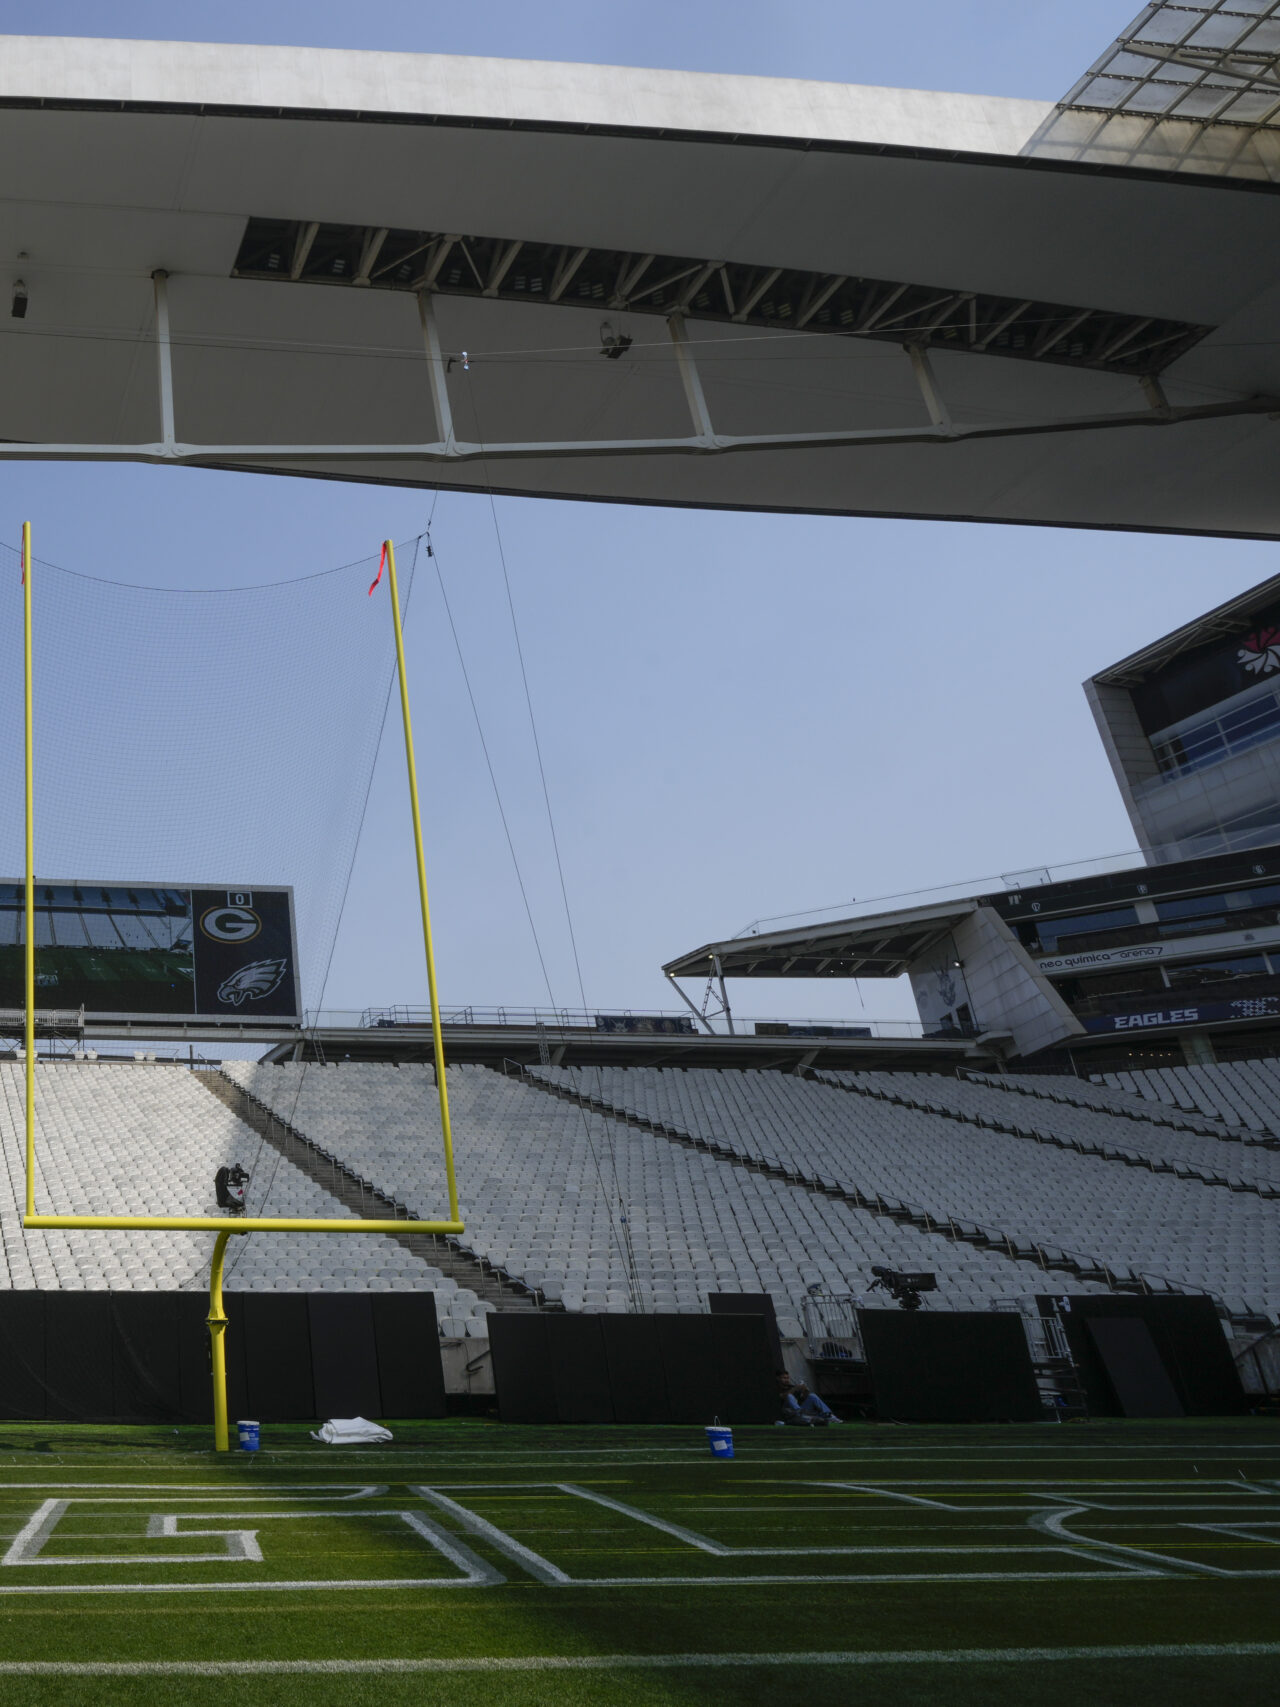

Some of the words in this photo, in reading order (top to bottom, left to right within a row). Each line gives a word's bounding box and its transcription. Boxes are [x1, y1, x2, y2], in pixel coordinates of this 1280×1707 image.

[236, 893, 245, 905] 0
[204, 908, 257, 940] G
[1039, 960, 1063, 969] neo
[1064, 953, 1111, 967] química
[1120, 948, 1154, 959] arena
[1114, 1008, 1199, 1029] EAGLES
